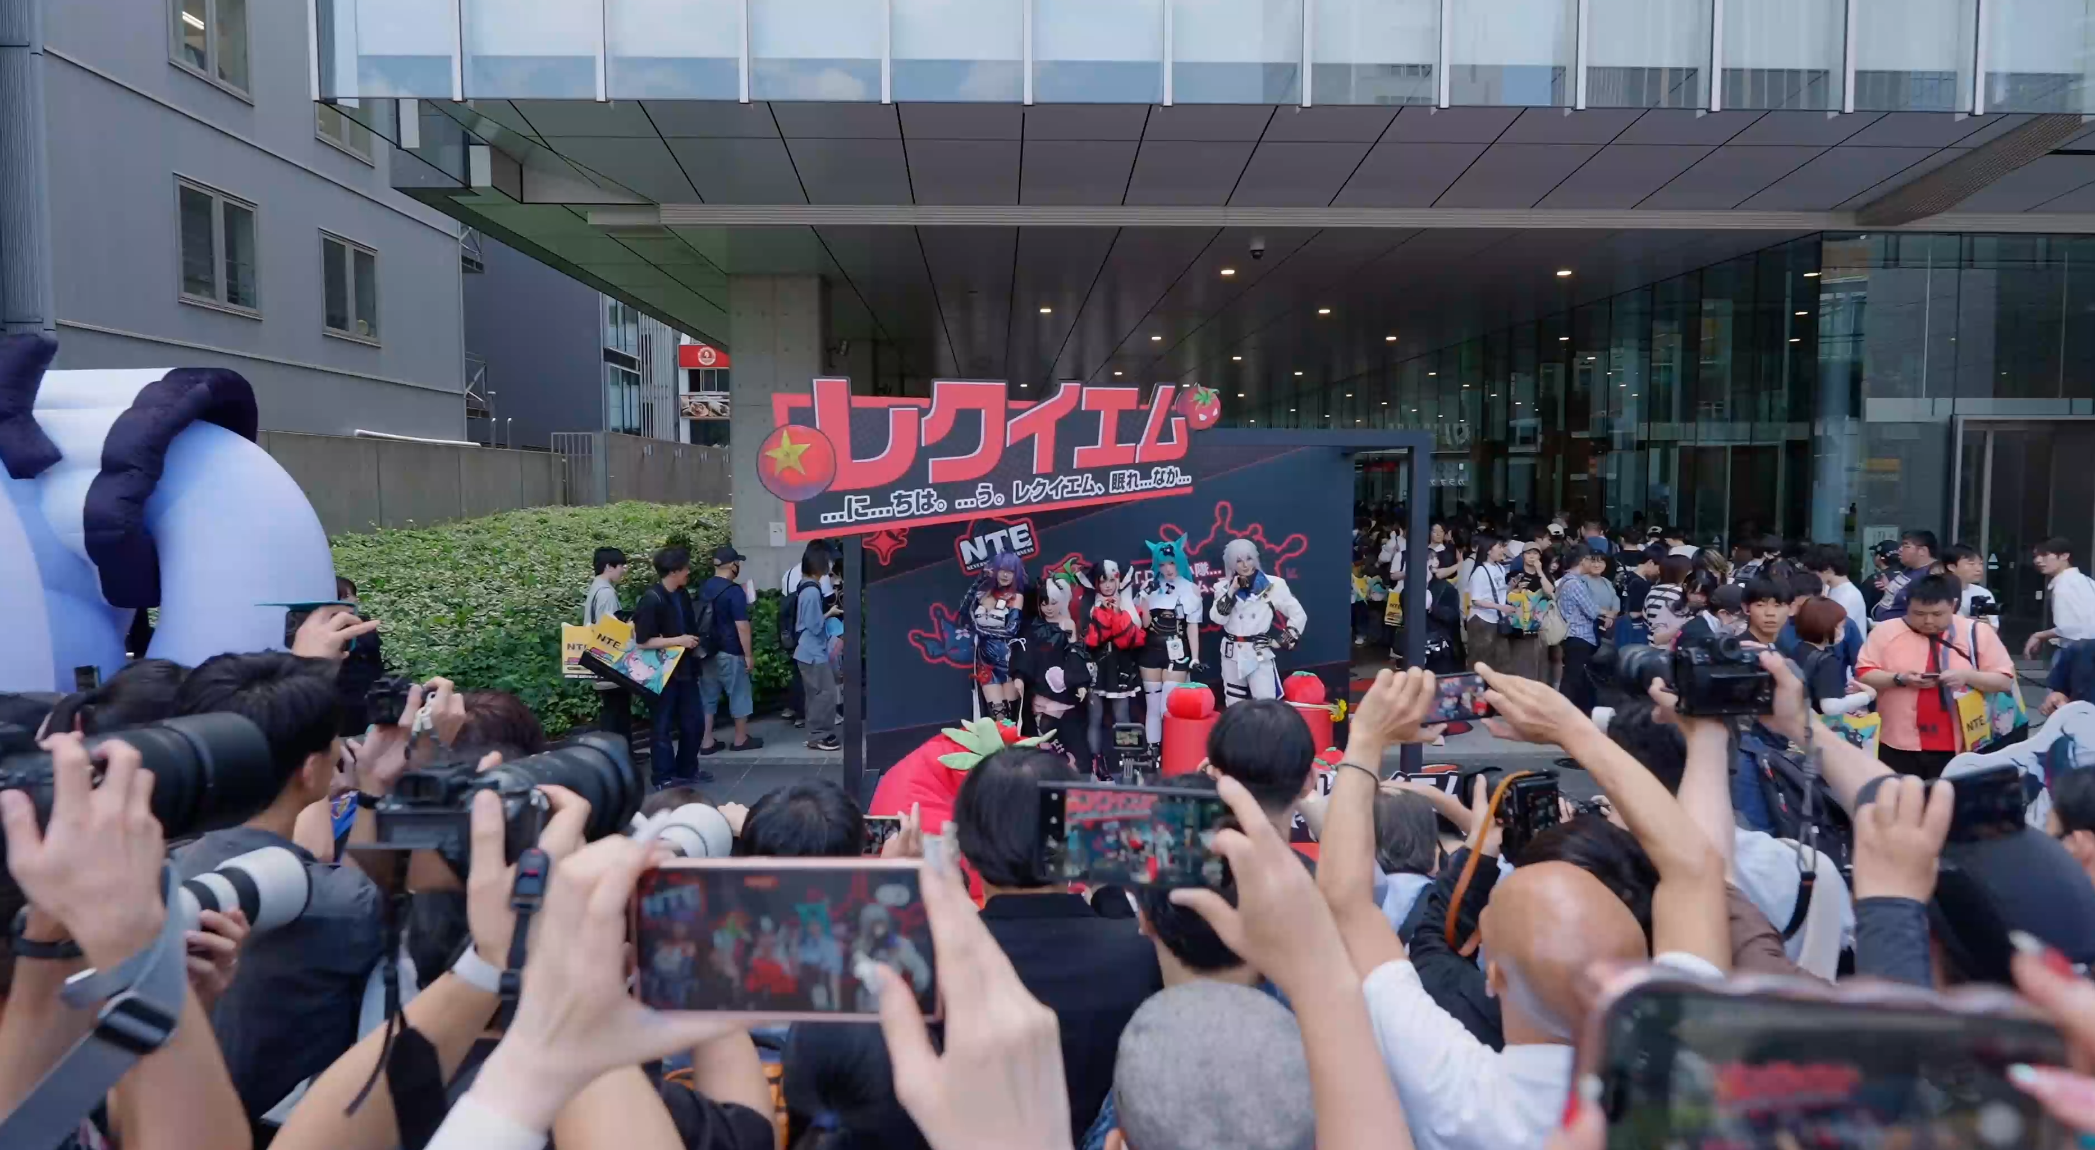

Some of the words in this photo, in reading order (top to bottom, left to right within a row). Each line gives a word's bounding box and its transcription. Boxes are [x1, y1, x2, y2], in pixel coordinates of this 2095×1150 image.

[811, 376, 1189, 491] レクイエム
[960, 523, 1033, 565] NTE
[596, 633, 621, 649] NTE
[1966, 714, 1985, 732] NTE
